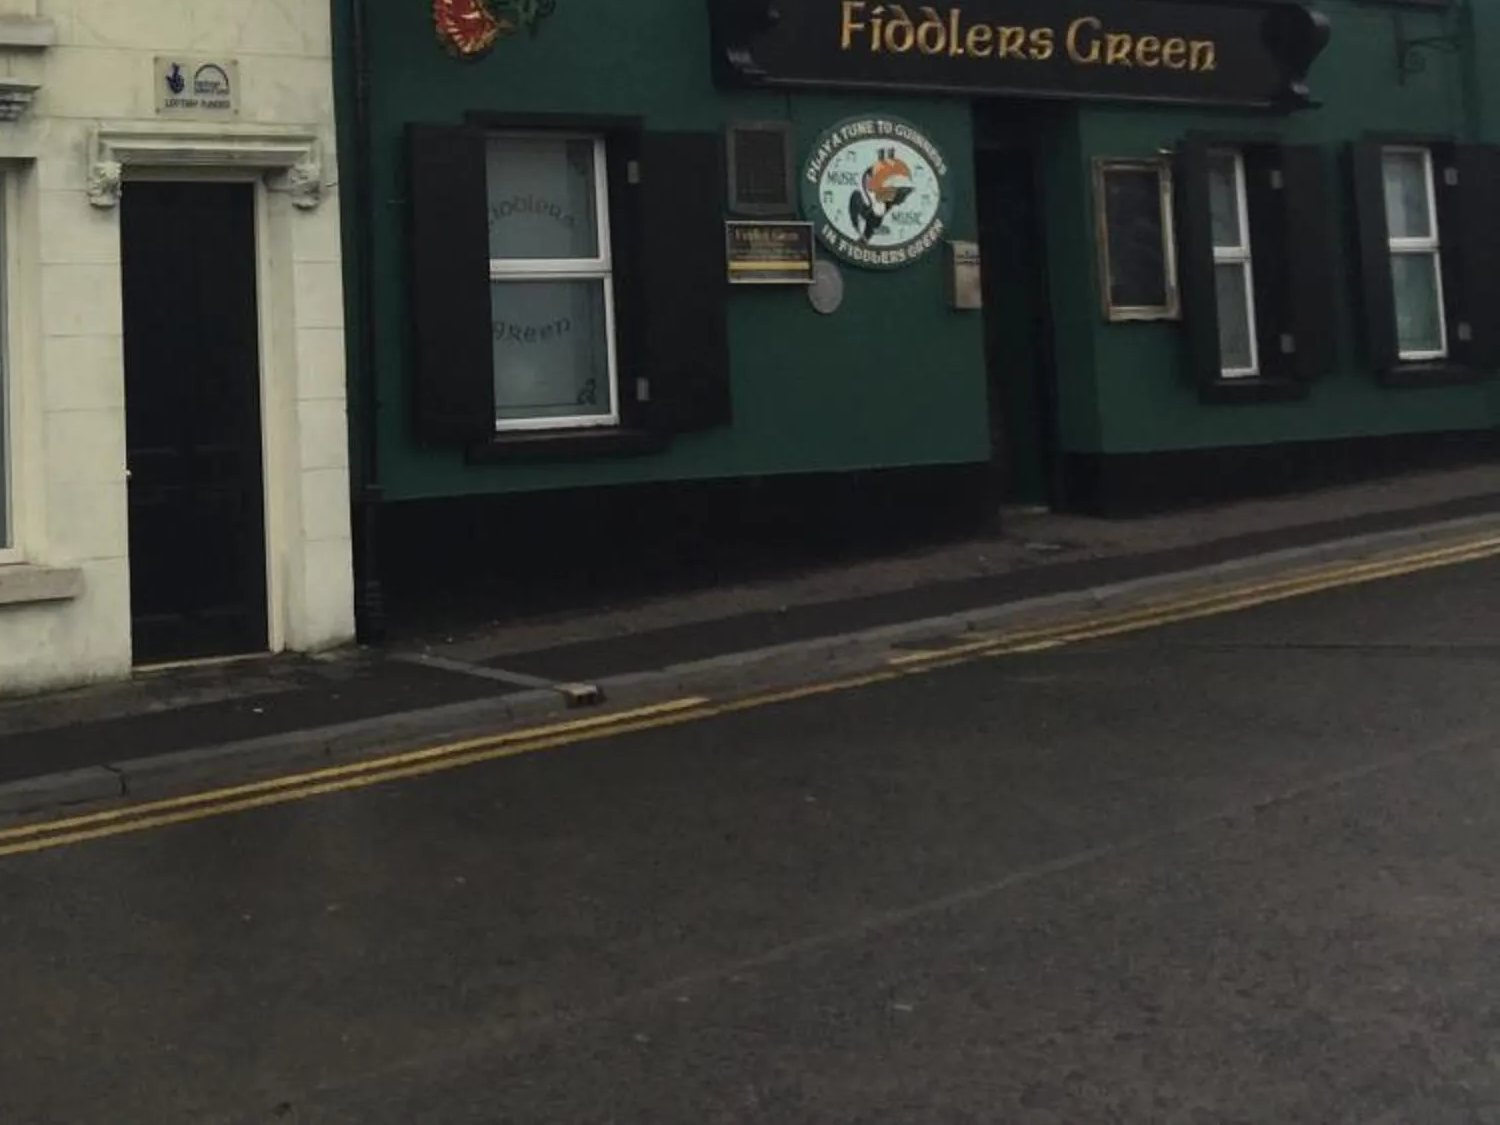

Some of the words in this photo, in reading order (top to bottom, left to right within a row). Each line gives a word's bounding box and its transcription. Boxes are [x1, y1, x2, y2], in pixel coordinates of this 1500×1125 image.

[840, 0, 1054, 61] Fiddlers
[1066, 16, 1217, 72] Green
[806, 137, 832, 183] PLAY
[832, 133, 844, 148] A
[841, 121, 875, 141] TUNE
[876, 120, 893, 135] TO
[838, 240, 906, 264] FIDDLERS
